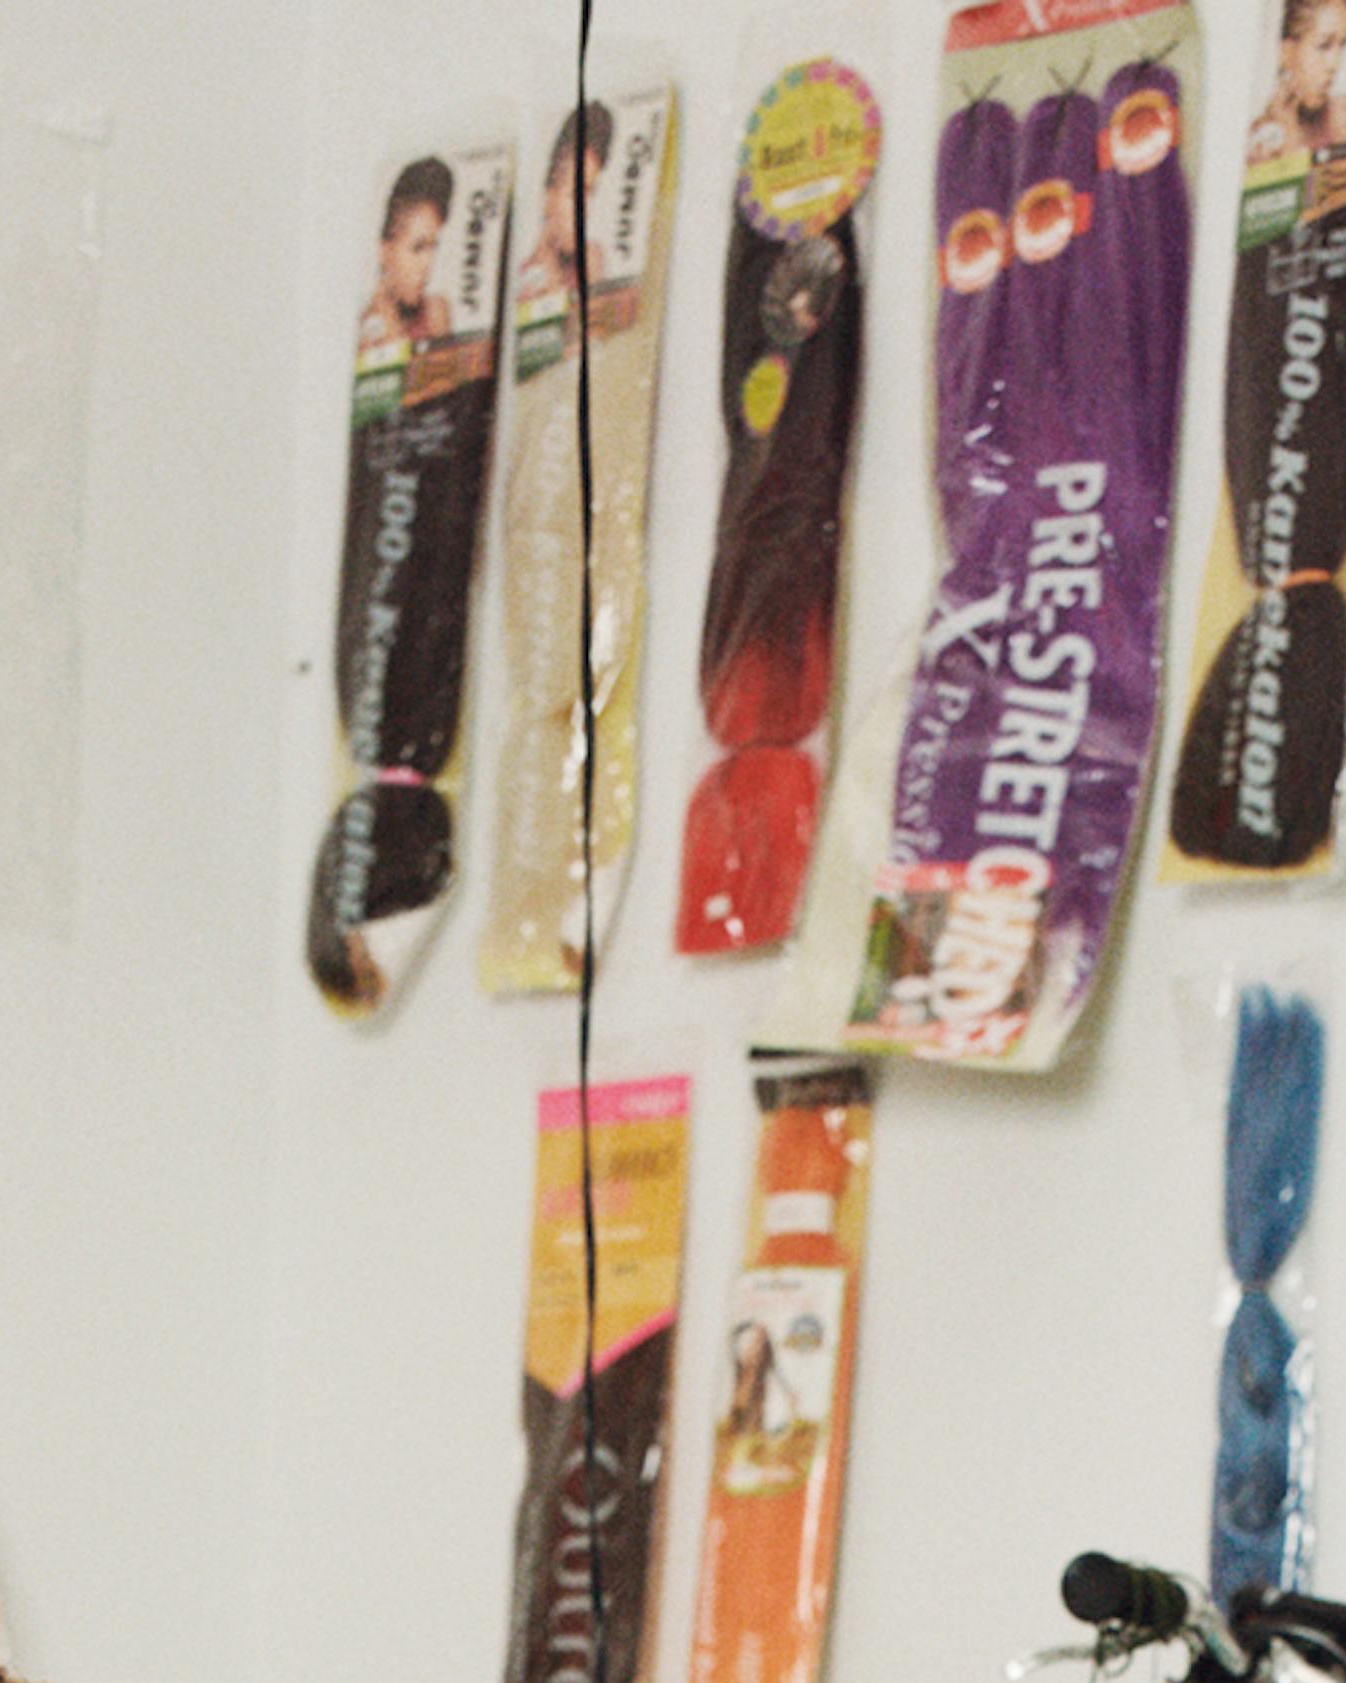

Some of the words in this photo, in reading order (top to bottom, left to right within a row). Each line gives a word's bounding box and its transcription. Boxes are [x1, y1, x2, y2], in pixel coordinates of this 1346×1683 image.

[1273, 293, 1329, 438] 100%
[930, 462, 1107, 1019] PRE-STRETCHED
[1238, 446, 1308, 838] Kanekalon
